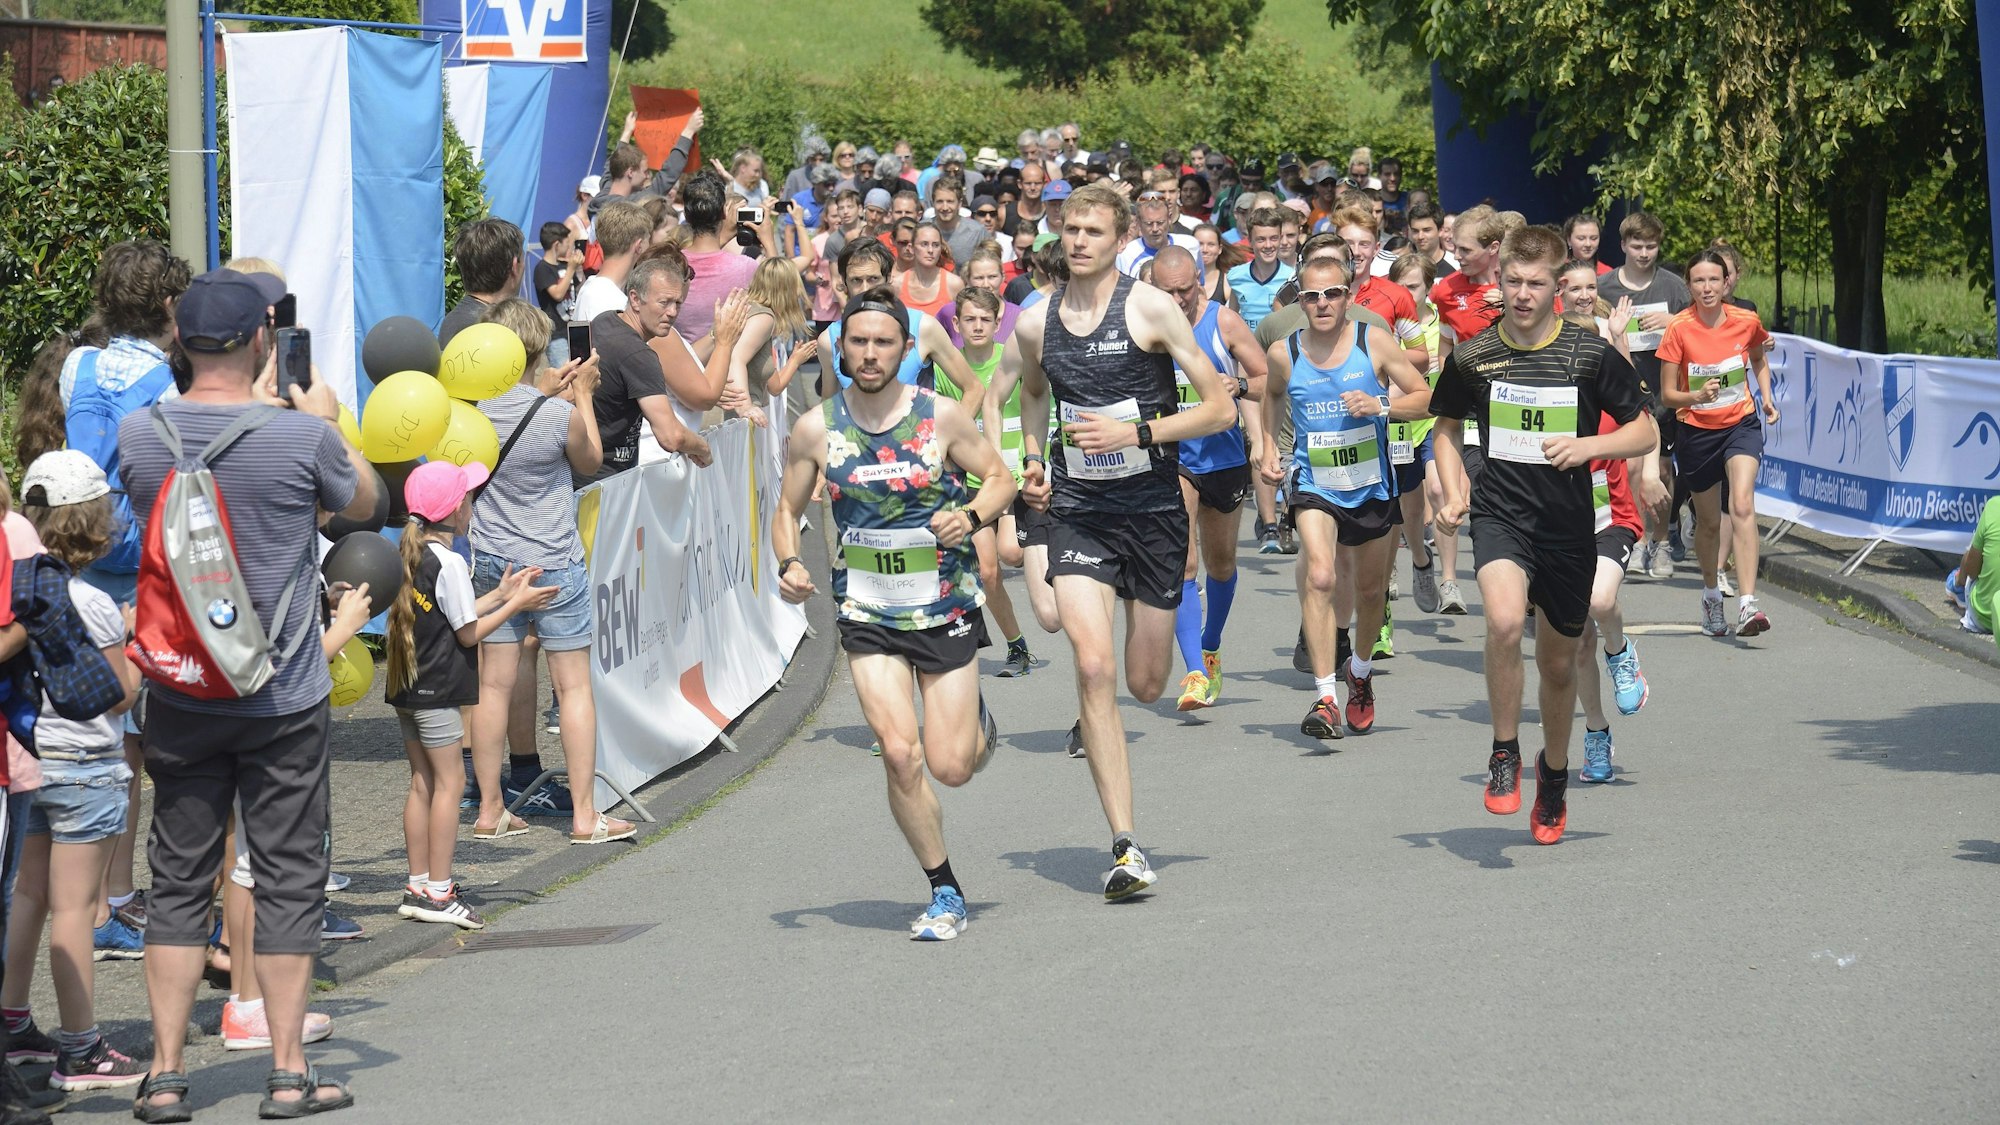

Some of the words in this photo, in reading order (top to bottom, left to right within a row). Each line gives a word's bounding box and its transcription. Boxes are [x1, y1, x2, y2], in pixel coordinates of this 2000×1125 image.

[1098, 340, 1129, 351] bunert
[445, 349, 480, 380] DJK
[1476, 360, 1510, 372] uhlsport
[1496, 386, 1510, 401] 14.
[1510, 394, 1537, 405] Dorflauf
[1521, 409, 1545, 432] 94
[384, 411, 420, 454] DJK
[1323, 438, 1346, 447] Dorflauf
[1398, 425, 1405, 441] 9
[1331, 446, 1359, 467] 109
[862, 466, 905, 477] SAYSKY
[1328, 466, 1360, 479] KLAUS
[1763, 460, 1787, 491] Triathlon
[1799, 468, 1815, 499] Union
[1814, 472, 1839, 505] Biesfeld
[1840, 478, 1868, 511] Triathlon
[1885, 486, 1922, 519] Union
[847, 532, 864, 545] 14.
[864, 537, 892, 548] Dorflauf
[874, 552, 906, 575] 115
[597, 566, 641, 675] BEW
